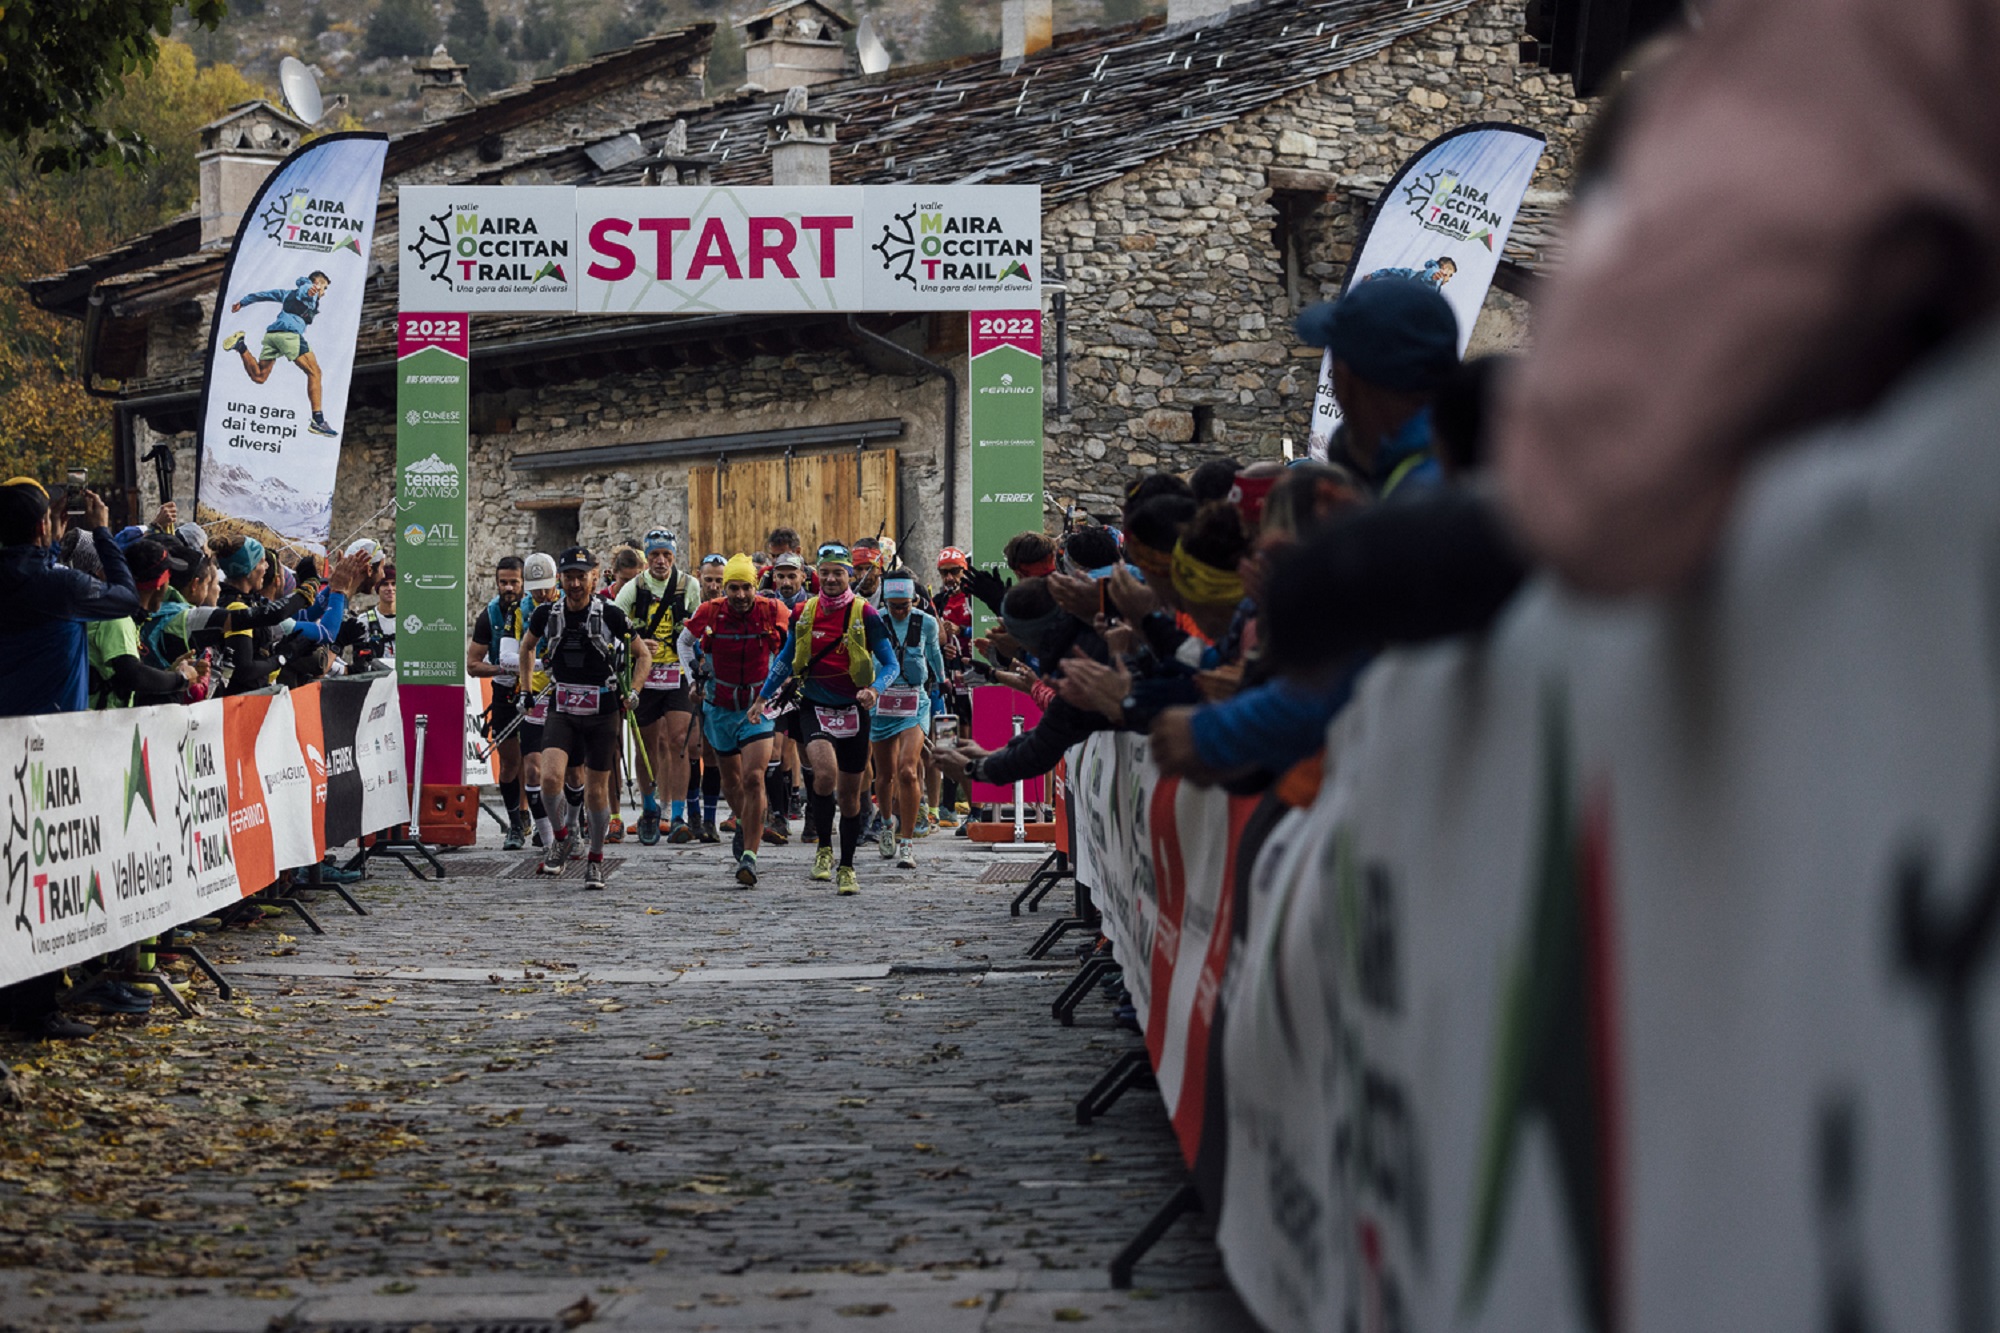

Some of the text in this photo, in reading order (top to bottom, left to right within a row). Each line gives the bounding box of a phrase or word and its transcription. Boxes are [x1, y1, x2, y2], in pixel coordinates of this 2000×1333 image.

[1438, 175, 1489, 206] MAIRA
[291, 194, 346, 215] MAIRA
[456, 203, 479, 211] valle
[920, 201, 944, 210] valle
[1434, 191, 1502, 229] OCCITAN
[288, 209, 364, 233] OCCITAN
[456, 213, 538, 235] MAIRA
[920, 213, 1004, 234] MAIRA
[1430, 205, 1472, 235] TRAIL
[287, 224, 336, 246] TRAIL
[456, 236, 568, 258] OCCITAN
[586, 216, 854, 282] START
[920, 235, 1033, 257] OCCITAN
[456, 260, 533, 281] TRAIL
[920, 259, 998, 281] TRAIL
[456, 284, 568, 295] Una gara dai tempi diversi
[920, 283, 1033, 294] Una gara dai tempi diversi
[405, 320, 461, 336] 2022
[978, 317, 1034, 334] 2022
[979, 386, 1035, 394] FERRINO
[1316, 384, 1337, 398] da
[227, 401, 295, 419] una gara
[222, 416, 297, 439] dai tempi
[229, 435, 282, 454] diversi
[404, 486, 460, 499] MONVISO
[994, 493, 1035, 503] TERREX
[427, 523, 459, 539] ATL
[420, 661, 457, 670] REGIONE
[420, 669, 457, 677] PIEMONTE
[893, 698, 902, 708] 3
[827, 715, 845, 727] 26
[330, 746, 356, 774] TERREX
[30, 760, 82, 812] MAIRA
[231, 802, 266, 836] FERRINO
[32, 814, 102, 867] OCCITAN
[193, 830, 223, 874] TRAIL
[33, 872, 85, 924] TRAIL
